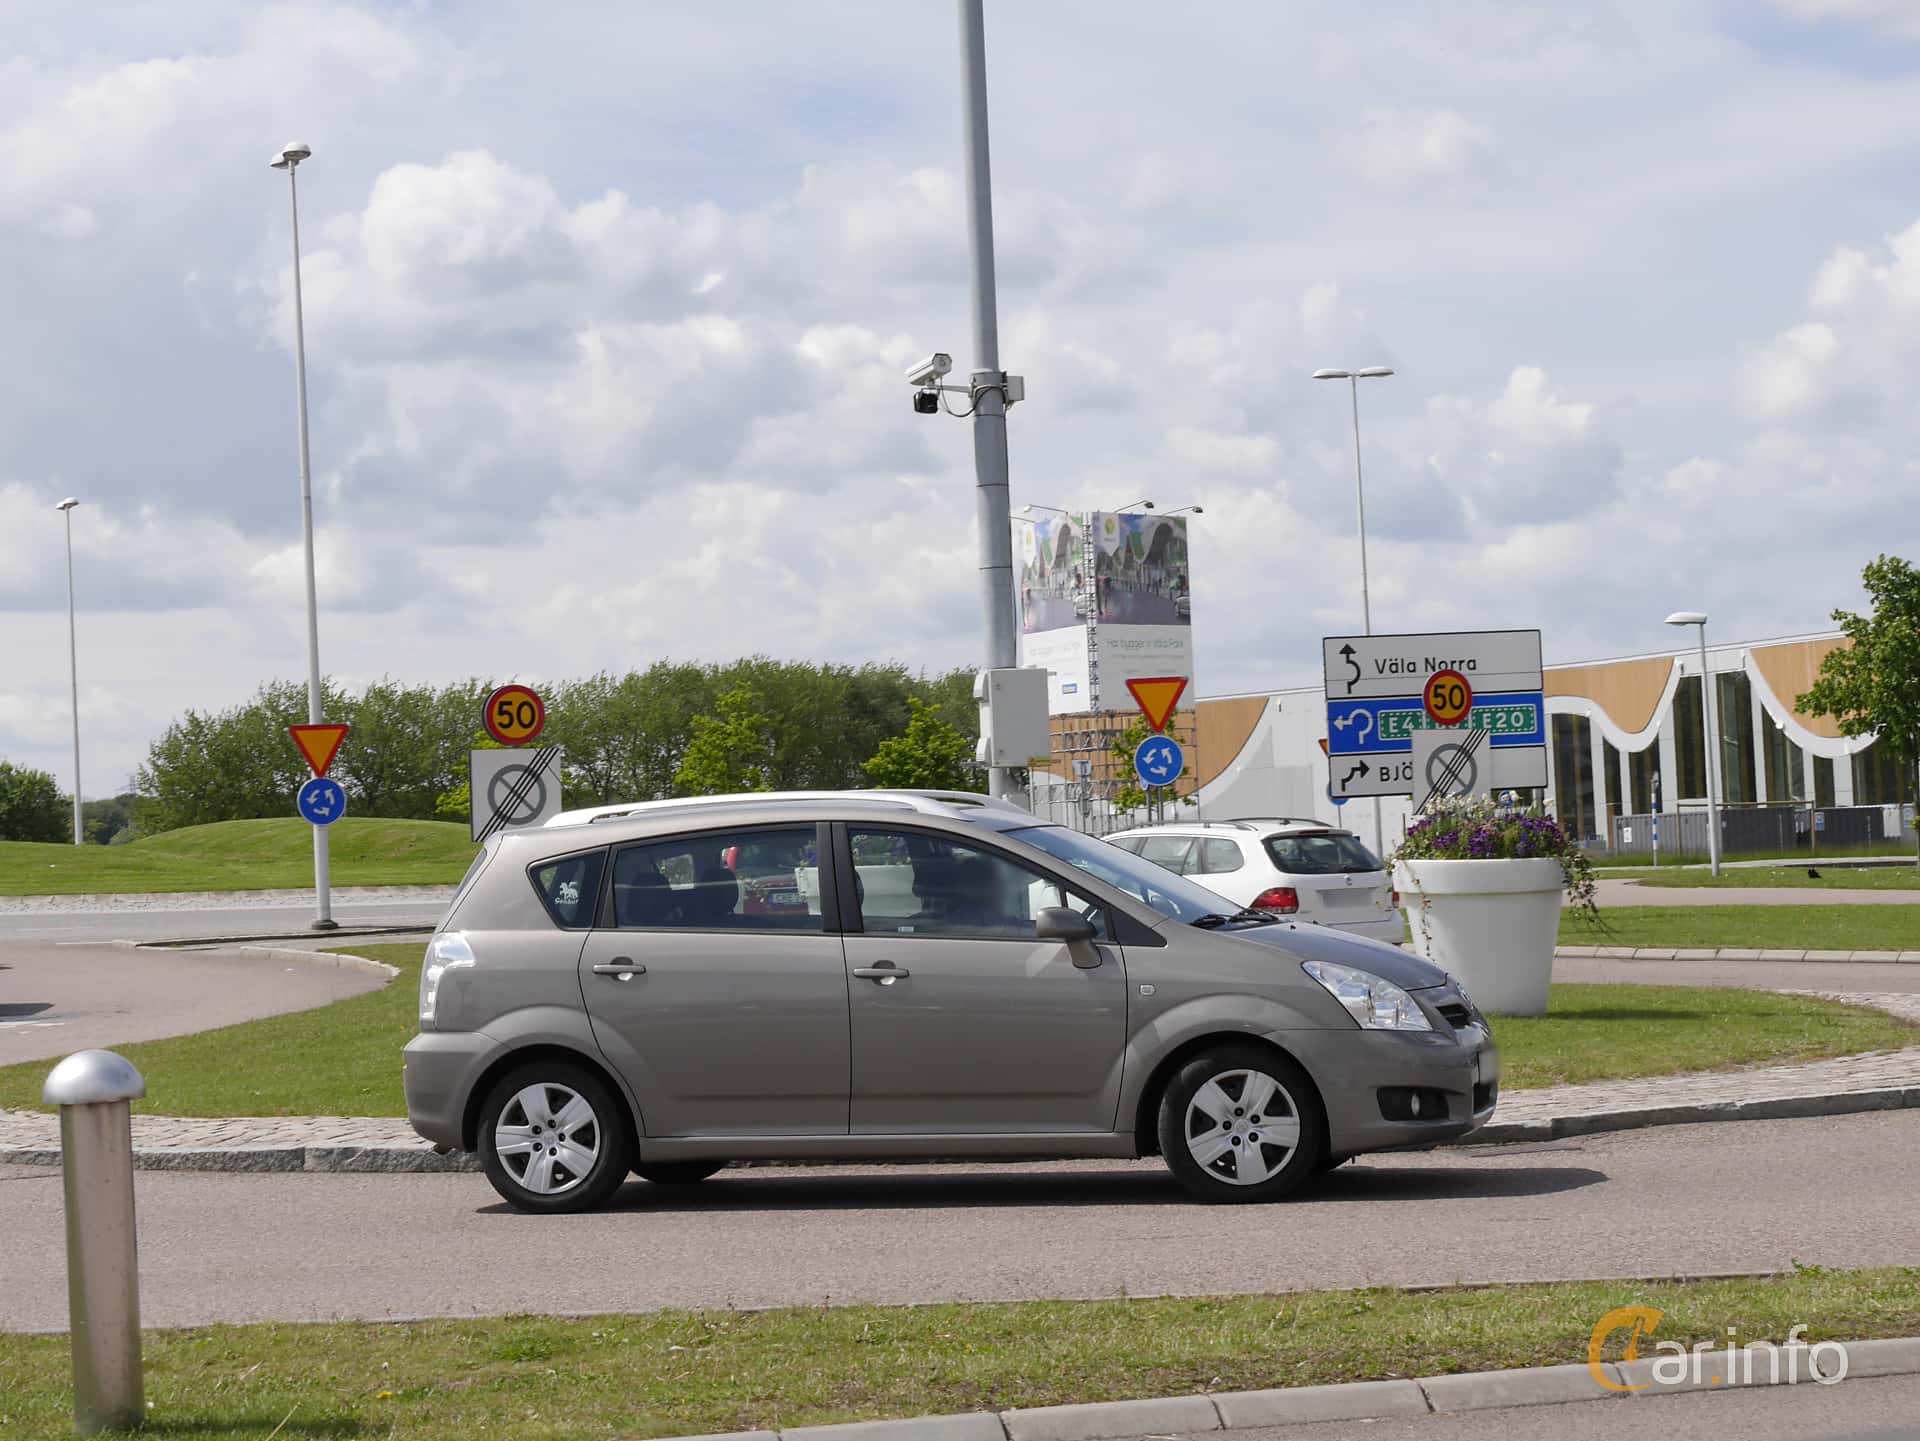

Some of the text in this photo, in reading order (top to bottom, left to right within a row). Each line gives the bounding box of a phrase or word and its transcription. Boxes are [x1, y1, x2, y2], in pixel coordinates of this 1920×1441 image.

[1374, 656, 1477, 674] Väla Norra
[1433, 683, 1465, 711] 50
[498, 700, 536, 729] 50
[1388, 716, 1415, 734] E4
[1482, 711, 1525, 728] E20
[1380, 761, 1414, 782] BJÖ
